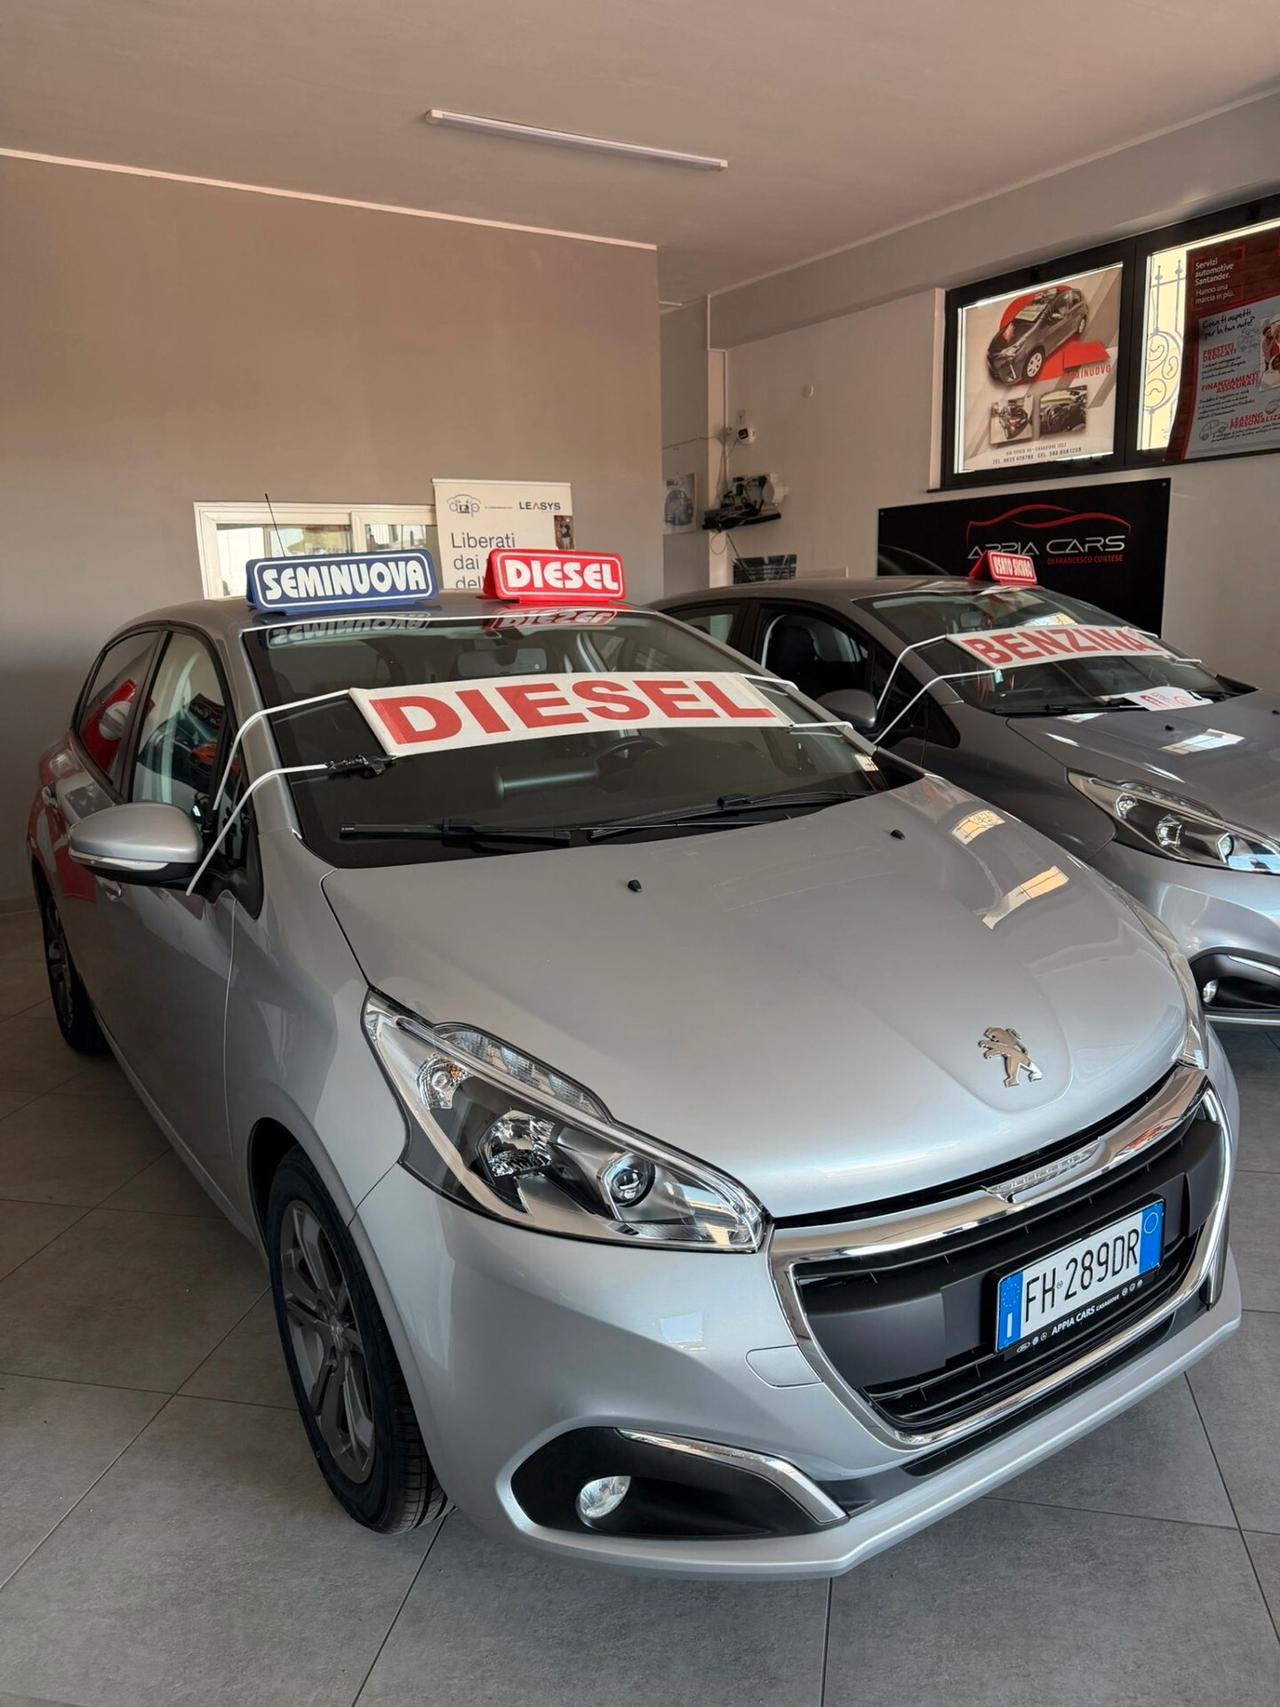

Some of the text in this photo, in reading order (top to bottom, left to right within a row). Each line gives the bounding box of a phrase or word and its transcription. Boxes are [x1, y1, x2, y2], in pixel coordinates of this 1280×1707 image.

[1195, 257, 1218, 270] Servizi
[519, 501, 561, 511] LEASYS
[451, 533, 515, 549] Liberati
[1046, 535, 1126, 554] CARS
[453, 554, 479, 570] dai
[1055, 556, 1092, 565] FRANCESCO
[1094, 554, 1123, 564] CORTESE
[262, 560, 427, 600] SEMINUOVA
[504, 559, 619, 590] DIESEL
[962, 627, 1162, 665] BENZINA
[369, 679, 777, 745] DIESEL
[1025, 1228, 1140, 1323] FH 289DR
[1051, 1317, 1075, 1336] APPIA
[1075, 1305, 1096, 1322] CARS
